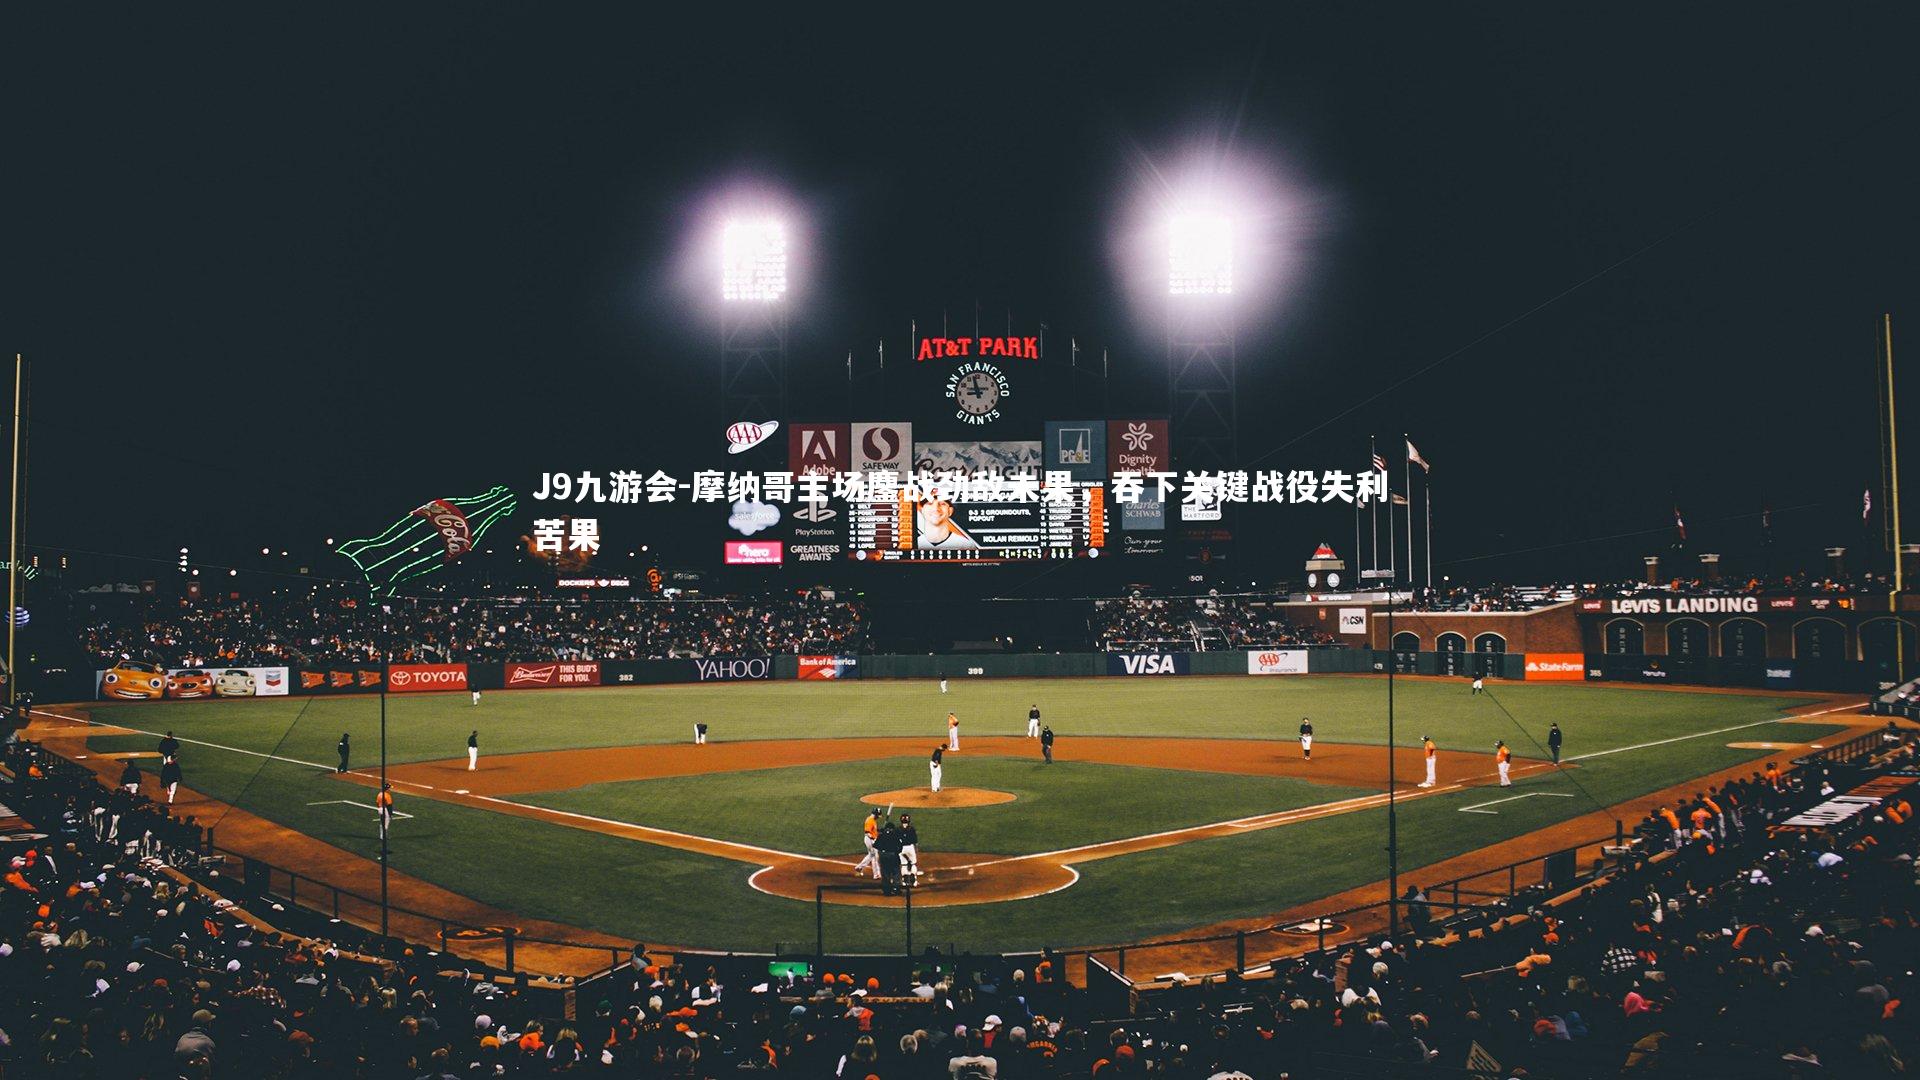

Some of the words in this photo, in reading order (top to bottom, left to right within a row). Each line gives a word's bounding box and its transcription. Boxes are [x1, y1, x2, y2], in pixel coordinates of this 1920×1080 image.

[917, 336, 973, 360] AT&T
[979, 337, 1038, 359] PARK
[945, 374, 959, 398] SAN
[958, 361, 1010, 397] FRANCISCO
[956, 409, 1001, 425] GIANTS
[1119, 454, 1157, 467] Dignity
[803, 464, 836, 476] Adobe
[734, 511, 775, 522] salesforce
[434, 514, 470, 555] Cola
[795, 529, 834, 537] PlayStation
[1124, 535, 1142, 545] Own
[1143, 537, 1163, 548] your
[790, 545, 840, 553] GREATNESS
[799, 553, 832, 561] AWAITS
[1665, 597, 1758, 613] LANDING
[1349, 616, 1364, 625] CSN
[800, 658, 817, 666] Bank
[818, 658, 825, 666] of
[826, 658, 856, 666] America
[1119, 654, 1175, 674] VISA
[1259, 653, 1280, 666] AAA
[514, 668, 551, 679] Budweiser
[559, 665, 575, 673] THIS
[576, 664, 598, 673] BUD'S
[695, 658, 770, 681] YAHOO!
[967, 667, 984, 675] 399
[413, 671, 467, 683] TOYOTA
[559, 674, 573, 682] FOR
[574, 673, 591, 682] YOU.
